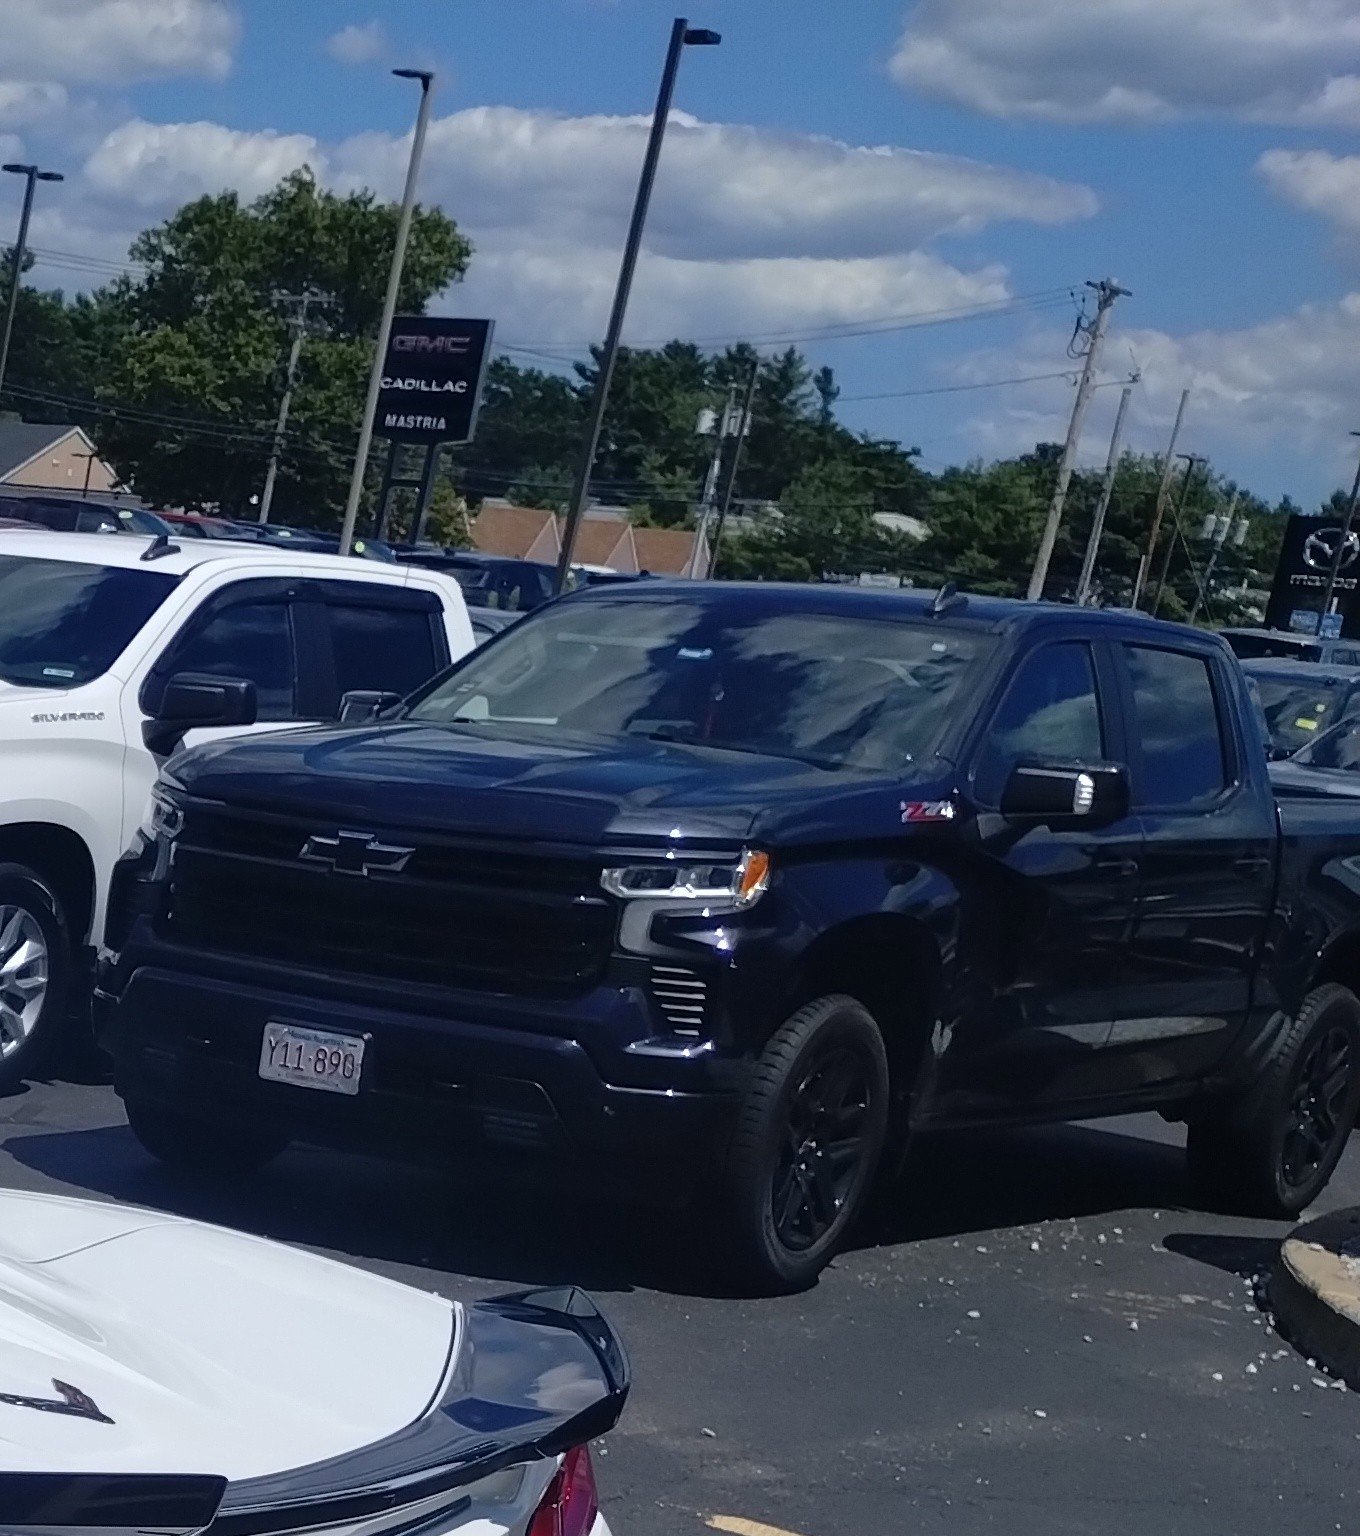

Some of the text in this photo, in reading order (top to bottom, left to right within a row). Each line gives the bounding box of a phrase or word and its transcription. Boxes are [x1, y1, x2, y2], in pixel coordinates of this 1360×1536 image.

[392, 335, 470, 353] GMC
[380, 376, 468, 393] CADILLAC
[385, 413, 446, 430] MASTRIA
